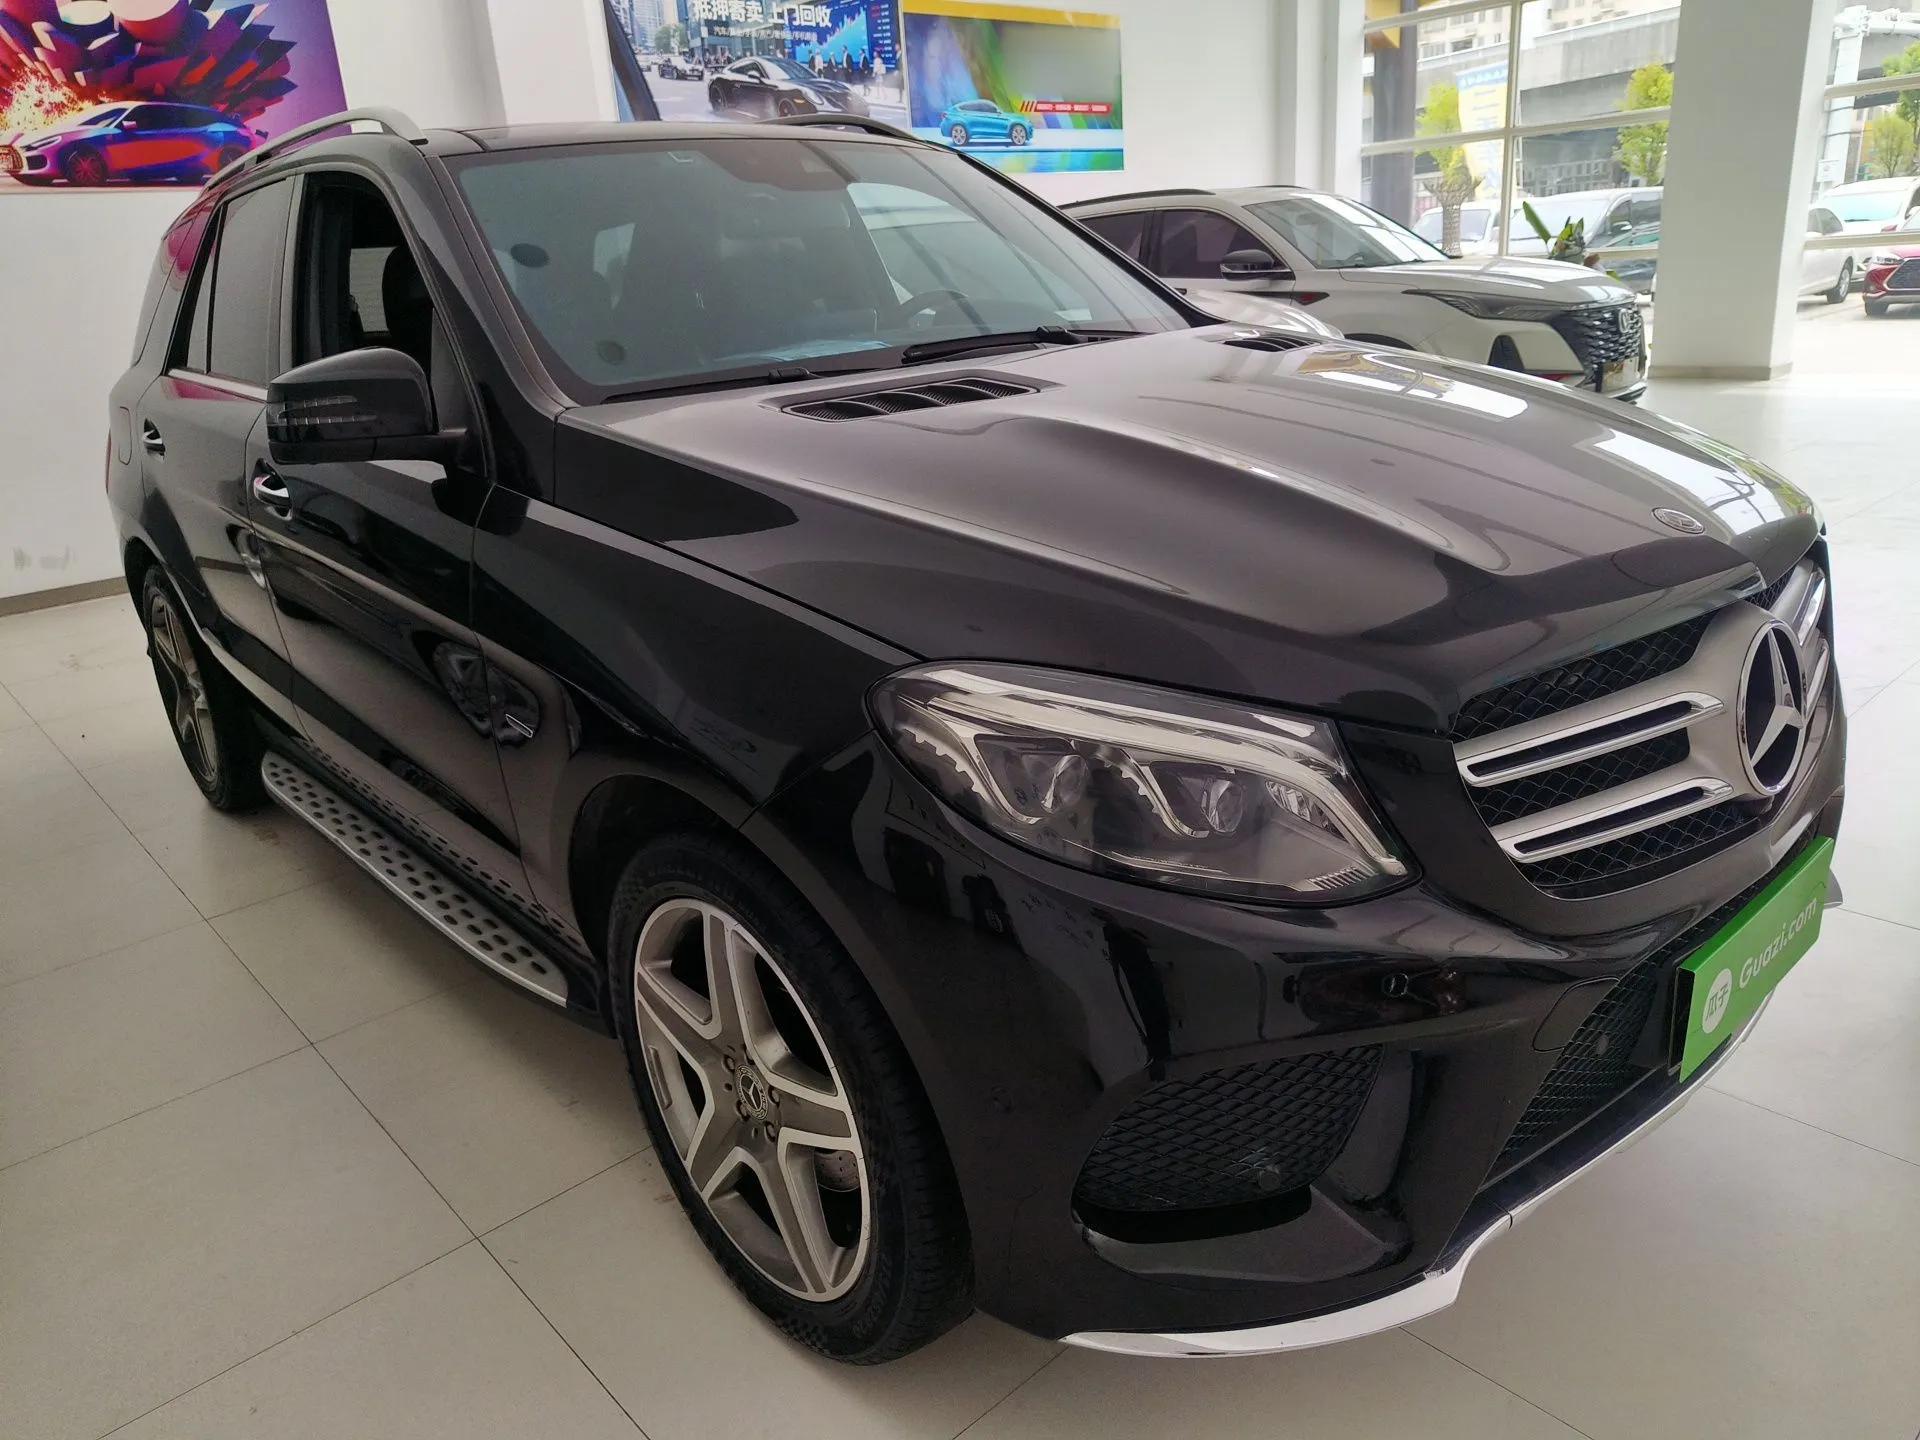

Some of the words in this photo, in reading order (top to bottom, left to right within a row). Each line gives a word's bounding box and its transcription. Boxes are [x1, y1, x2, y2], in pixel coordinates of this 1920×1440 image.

[693, 0, 764, 22] 抵押寄卖
[768, 4, 832, 27] 上门回收
[1739, 898, 1818, 989] Guazi.com
